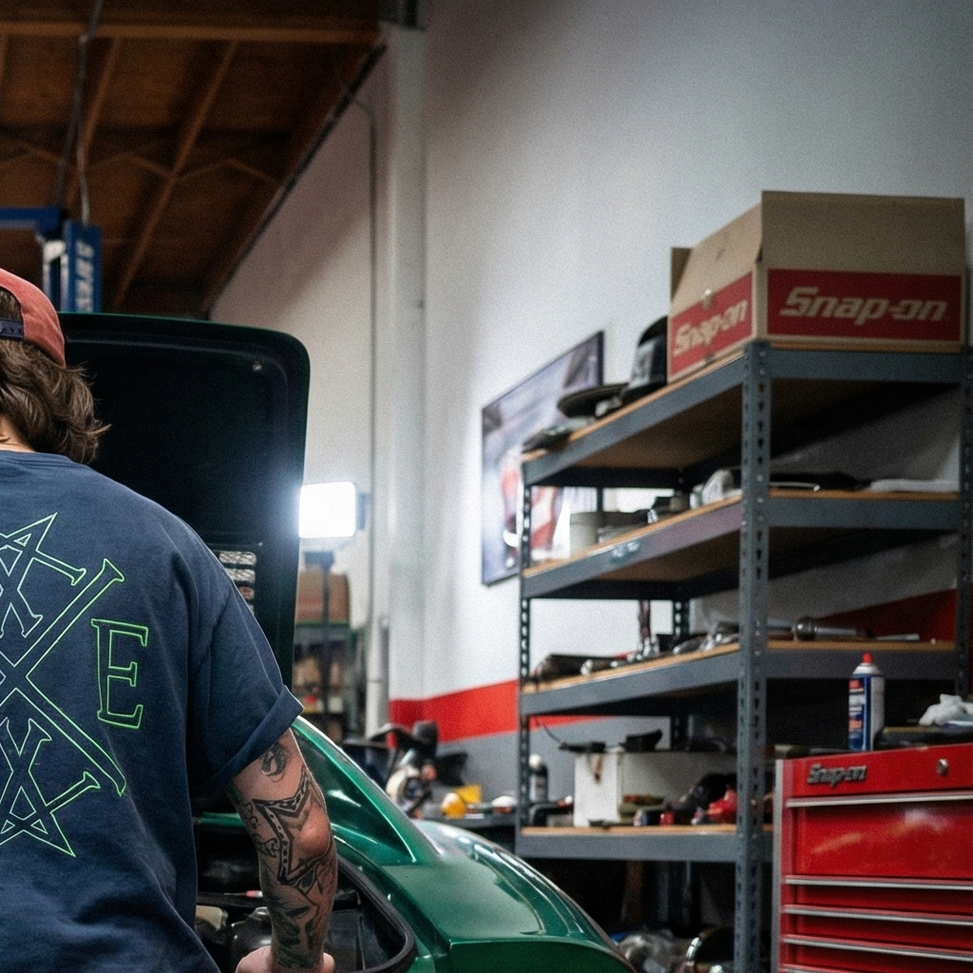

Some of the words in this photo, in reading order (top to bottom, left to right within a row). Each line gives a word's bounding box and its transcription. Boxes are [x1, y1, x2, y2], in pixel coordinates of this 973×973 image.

[672, 300, 748, 357] Snap-on
[779, 286, 948, 326] Snap-on
[90, 617, 149, 730] E
[806, 763, 868, 788] Snap-on
